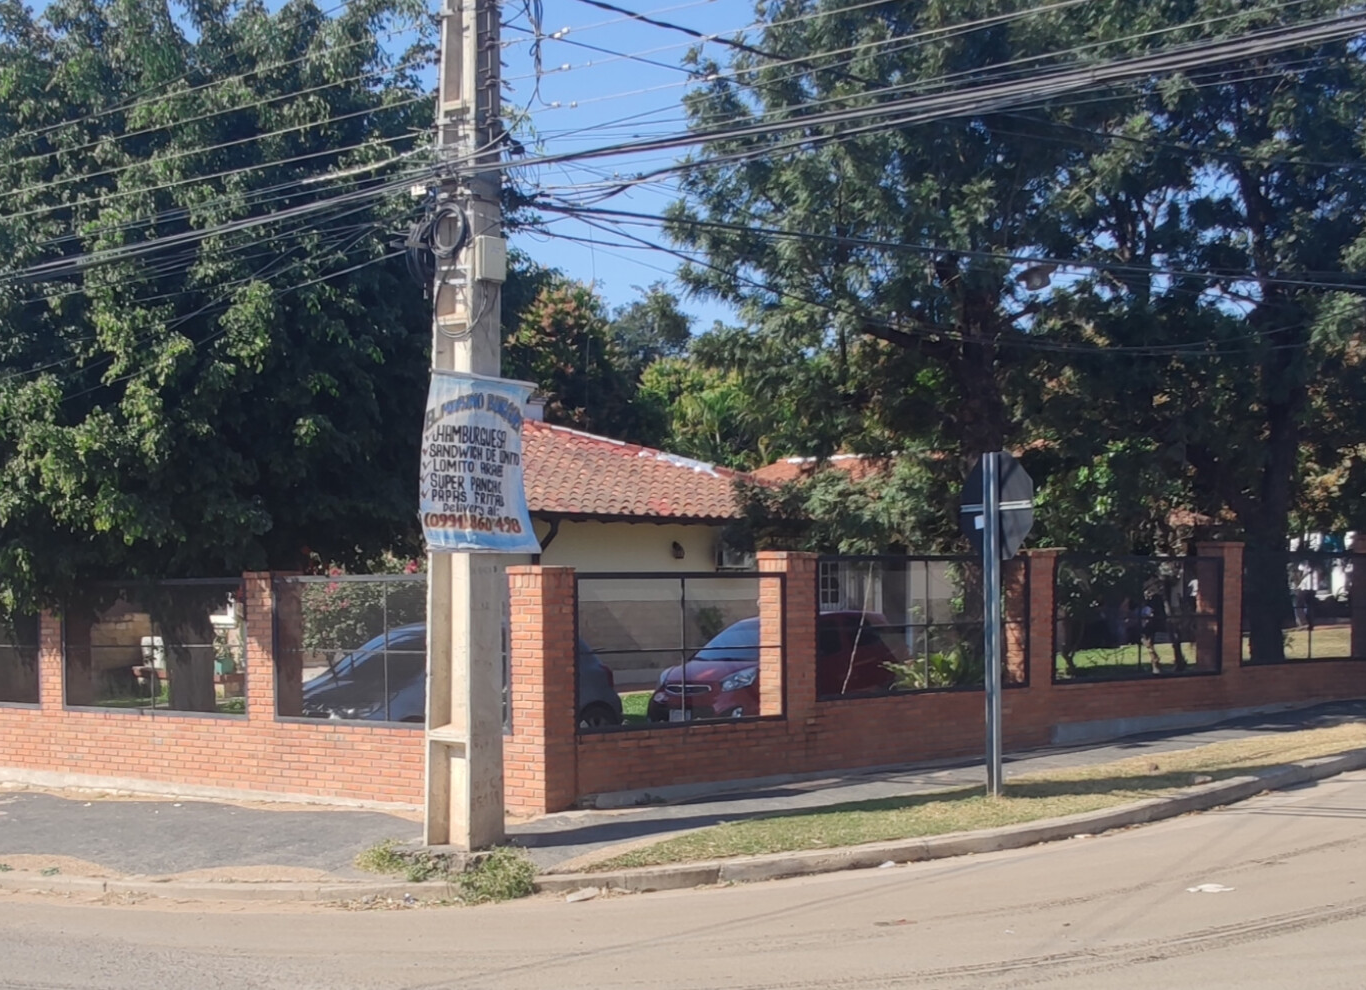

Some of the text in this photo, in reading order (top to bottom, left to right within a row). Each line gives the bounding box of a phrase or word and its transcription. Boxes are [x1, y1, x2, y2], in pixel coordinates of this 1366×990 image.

[429, 443, 483, 460] SANDWICH
[485, 448, 497, 462] DE
[433, 458, 475, 473] LOMITO
[430, 473, 465, 490] SUPER
[431, 489, 467, 503] PAPAS
